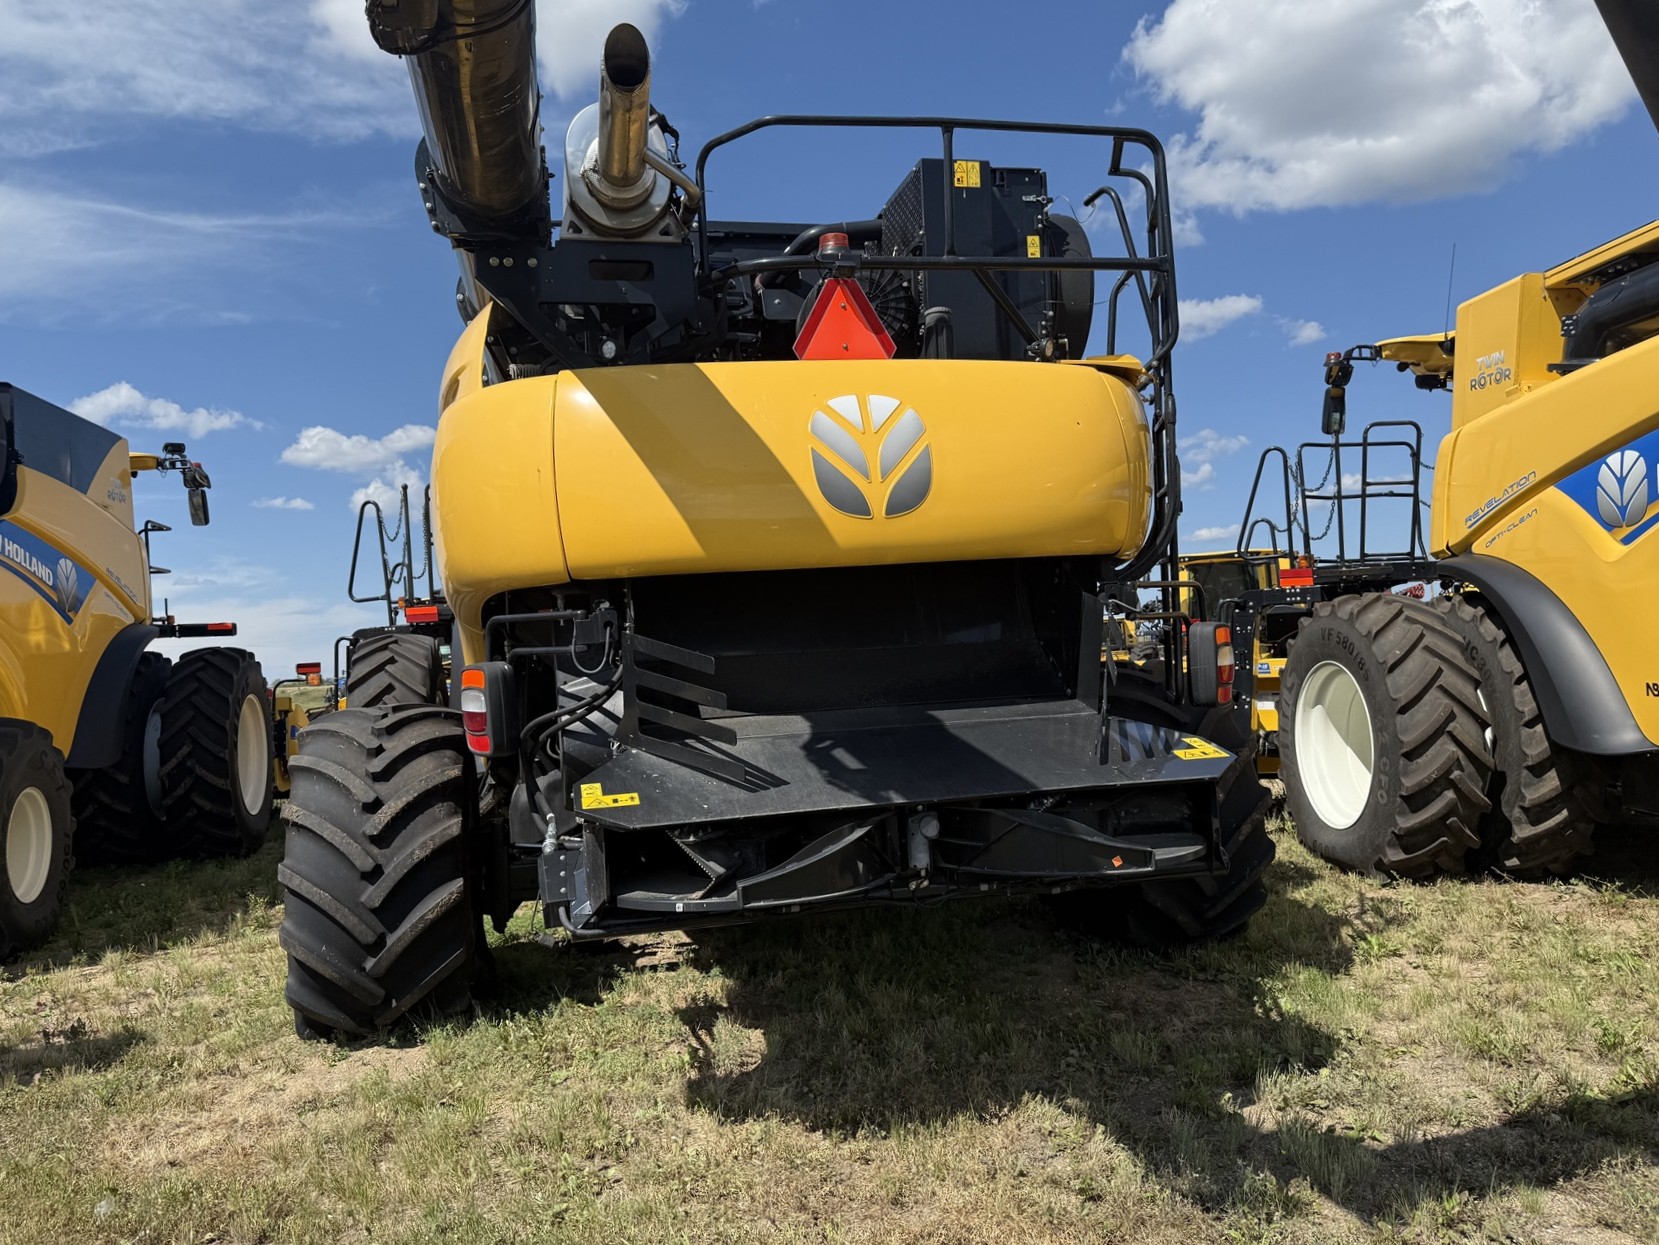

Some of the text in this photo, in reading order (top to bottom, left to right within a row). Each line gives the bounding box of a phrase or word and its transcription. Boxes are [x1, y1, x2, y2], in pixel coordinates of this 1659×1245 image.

[1470, 366, 1511, 392] ROTOR
[1476, 349, 1505, 371] TWIN
[1464, 471, 1536, 526] REVELATION
[1485, 508, 1538, 549] OPTI-CLEAN
[4, 537, 54, 587] HOLLAND
